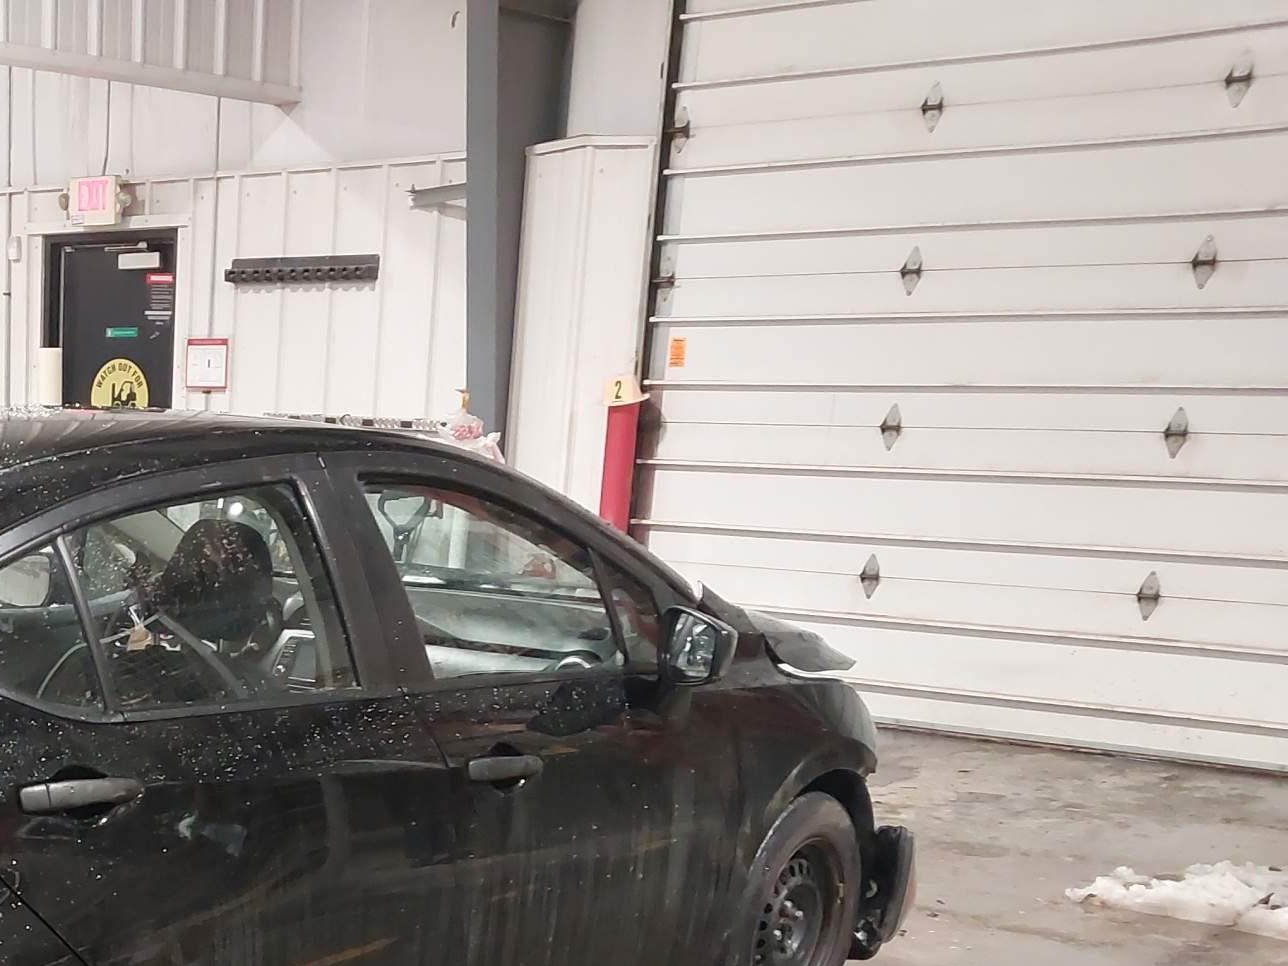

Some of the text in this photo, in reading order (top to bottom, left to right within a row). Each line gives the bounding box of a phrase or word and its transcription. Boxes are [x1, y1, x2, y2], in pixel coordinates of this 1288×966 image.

[96, 362, 144, 388] WATCH OUT FOR
[614, 380, 622, 400] 2
